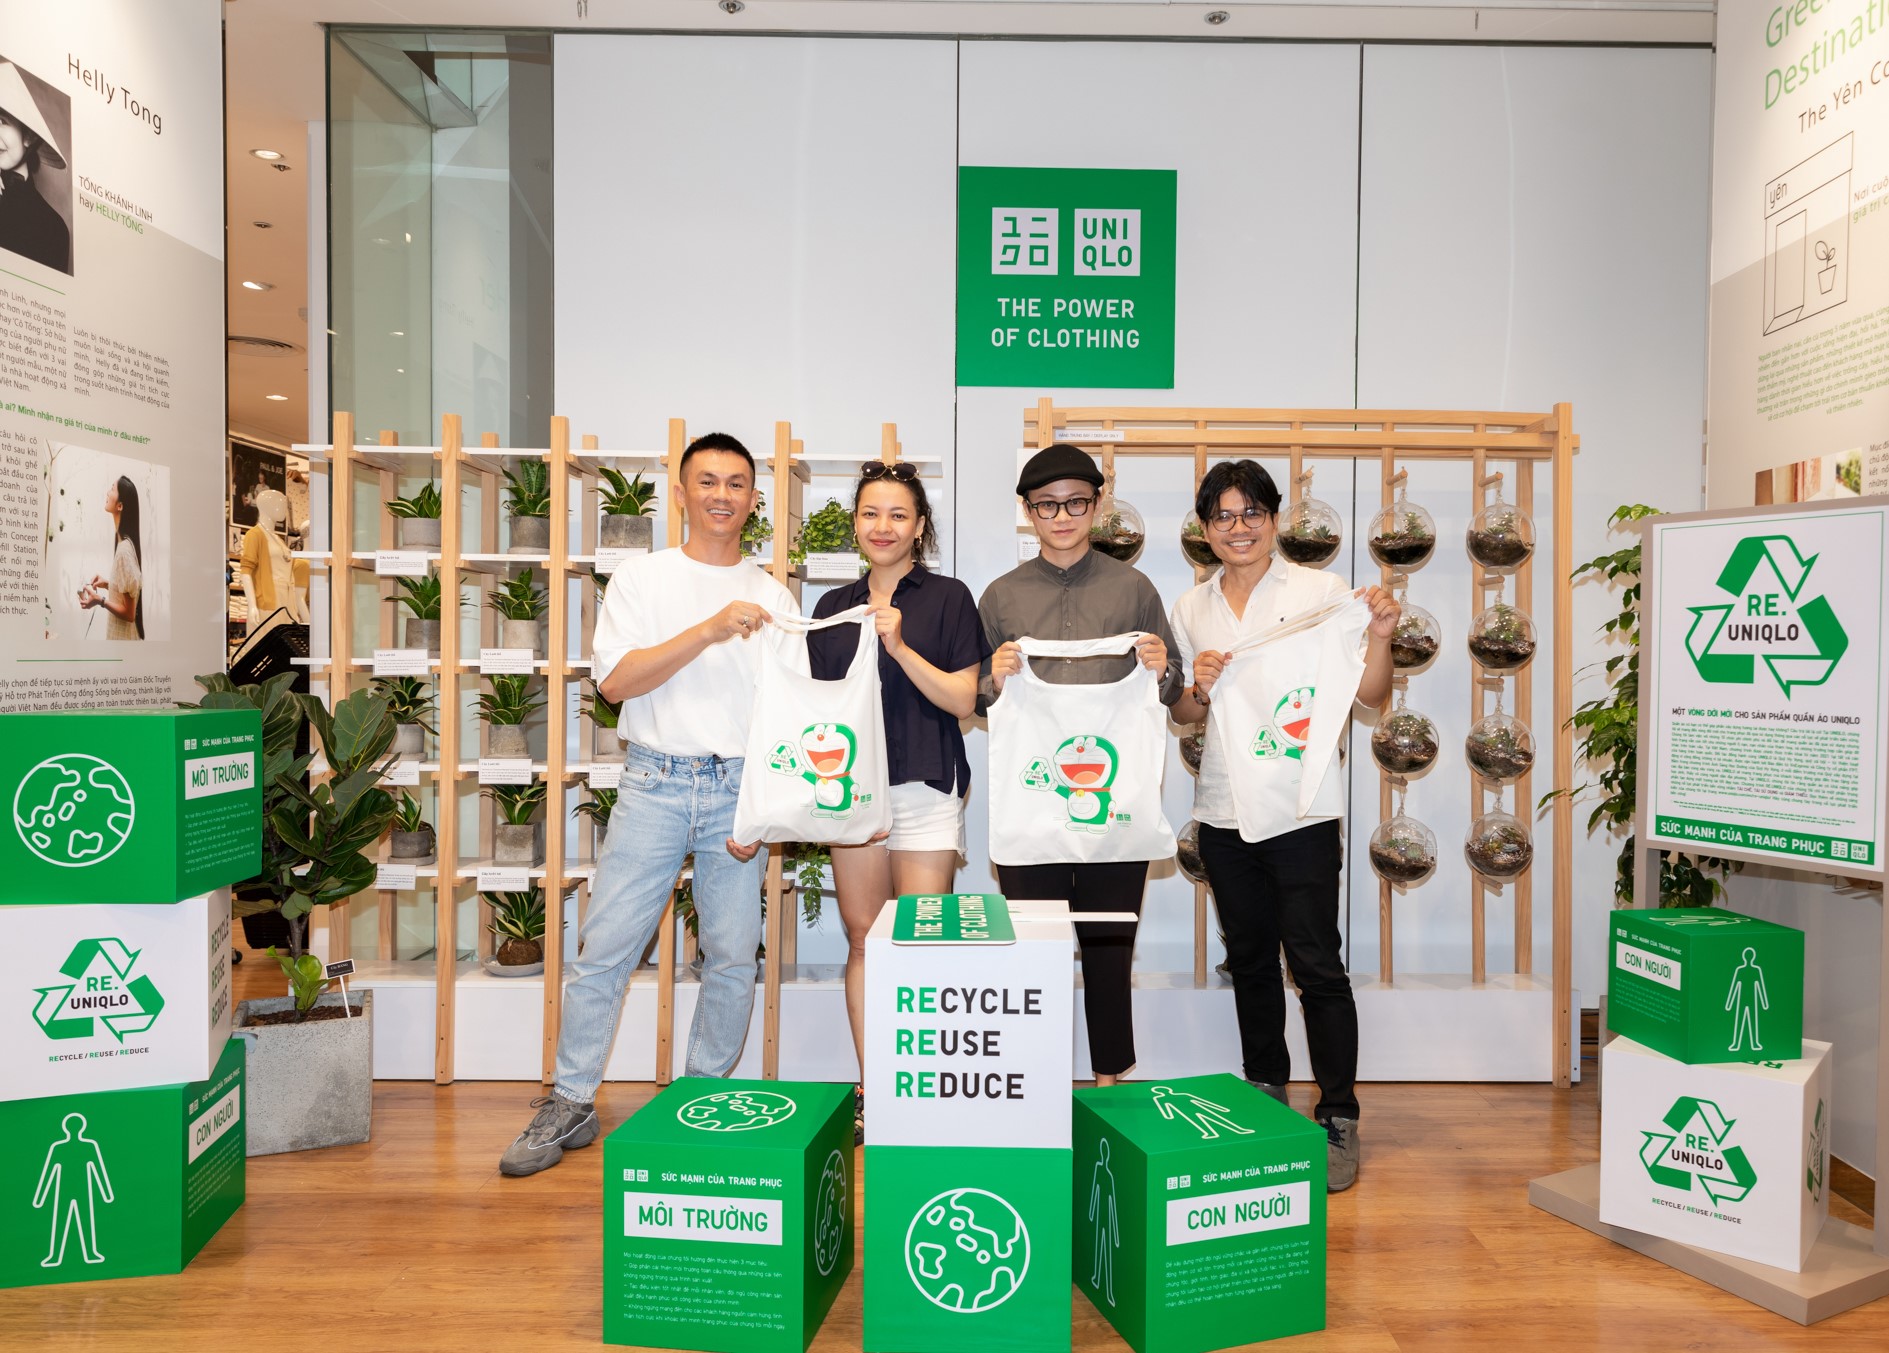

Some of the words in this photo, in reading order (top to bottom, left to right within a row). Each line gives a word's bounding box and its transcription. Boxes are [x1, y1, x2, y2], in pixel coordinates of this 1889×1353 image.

[1765, 0, 1889, 110] Destinati
[68, 53, 115, 104] Helly
[121, 87, 162, 134] Tong
[1799, 104, 1827, 133] The
[1833, 80, 1862, 111] Yên
[79, 176, 103, 198] TỐNG
[105, 188, 134, 212] KHÁNH
[135, 207, 152, 223] LINH
[1769, 182, 1787, 209] yên
[79, 194, 94, 213] hay
[96, 203, 121, 223] HELLY
[122, 215, 143, 234] TỐNG
[1083, 218, 1128, 239] UNI
[1082, 246, 1132, 270] QLO
[12, 292, 27, 304] Linh,
[997, 298, 1041, 317] THE
[1054, 299, 1134, 318] POWER
[7, 304, 20, 314] hơn
[43, 318, 54, 326] qua
[992, 329, 1019, 347] OF
[1028, 329, 1140, 348] CLOTHING
[58, 358, 66, 366] vai
[5, 403, 16, 411] ai?
[38, 411, 54, 422] nhận
[56, 416, 62, 424] ra
[64, 418, 74, 427] giá
[14, 446, 25, 454] sau
[27, 446, 37, 457] khi
[6, 518, 21, 528] hình
[24, 519, 38, 530] kinh
[11, 533, 38, 542] Concept
[14, 545, 38, 555] Station,
[1747, 594, 1786, 616] RE.
[1728, 624, 1799, 644] UNIQLO
[12, 679, 27, 688] chọn
[40, 678, 52, 687] tiếp
[54, 678, 64, 687] tục
[1672, 708, 1685, 716] MỘT
[1734, 711, 1749, 719] CHO
[1751, 710, 1766, 720] SẢN
[1769, 710, 1790, 721] PHẨM
[1817, 712, 1828, 723] ÁO
[1831, 716, 1860, 725] UNIQLO
[192, 765, 208, 787] MÔI
[213, 760, 248, 784] TRƯỜNG
[1661, 820, 1680, 834] SỨC
[1685, 825, 1715, 840] MẠNH
[1720, 827, 1743, 842] CỦA
[1748, 832, 1787, 849] TRANG
[1792, 838, 1824, 853] PHỤC
[916, 897, 942, 919] POWER
[958, 895, 988, 928] CLOTHING
[211, 914, 229, 957] RECYCLE
[914, 920, 942, 937] THE
[961, 928, 989, 938] OF
[1625, 952, 1641, 968] CON
[1645, 962, 1671, 979] NGƯỜI
[86, 975, 119, 993] RE.
[71, 994, 129, 1010] UNIQLO
[897, 986, 1042, 1014] RECYCLE
[896, 1029, 1000, 1056] REUSE
[49, 1053, 83, 1062] RECYCLE
[90, 1050, 114, 1059] REUSE
[120, 1047, 150, 1056] REDUCE
[896, 1071, 1024, 1099] REDUCE
[197, 1119, 211, 1146] CON
[214, 1099, 233, 1131] NGƯỜI
[1685, 1133, 1714, 1152] RE.
[1671, 1149, 1723, 1170] UNIQLO
[662, 1171, 677, 1181] SỨC
[681, 1174, 704, 1184] MẠNH
[708, 1173, 724, 1184] CỦA
[728, 1176, 756, 1186] TRANG
[760, 1178, 782, 1189] PHỤC
[1203, 1172, 1217, 1183] SỨC
[1220, 1170, 1242, 1181] MẠNH
[1245, 1166, 1260, 1177] CỦA
[1264, 1163, 1288, 1174] TRANG
[1291, 1160, 1310, 1172] PHỤC
[638, 1201, 673, 1227] MÔI
[683, 1205, 768, 1232] TRƯỜNG
[1187, 1206, 1226, 1230] CON
[1235, 1192, 1291, 1223] NGƯỜI
[1652, 1197, 1681, 1210] RECYCLE
[1686, 1206, 1709, 1216] REUSE
[1713, 1213, 1741, 1224] REDUCE
